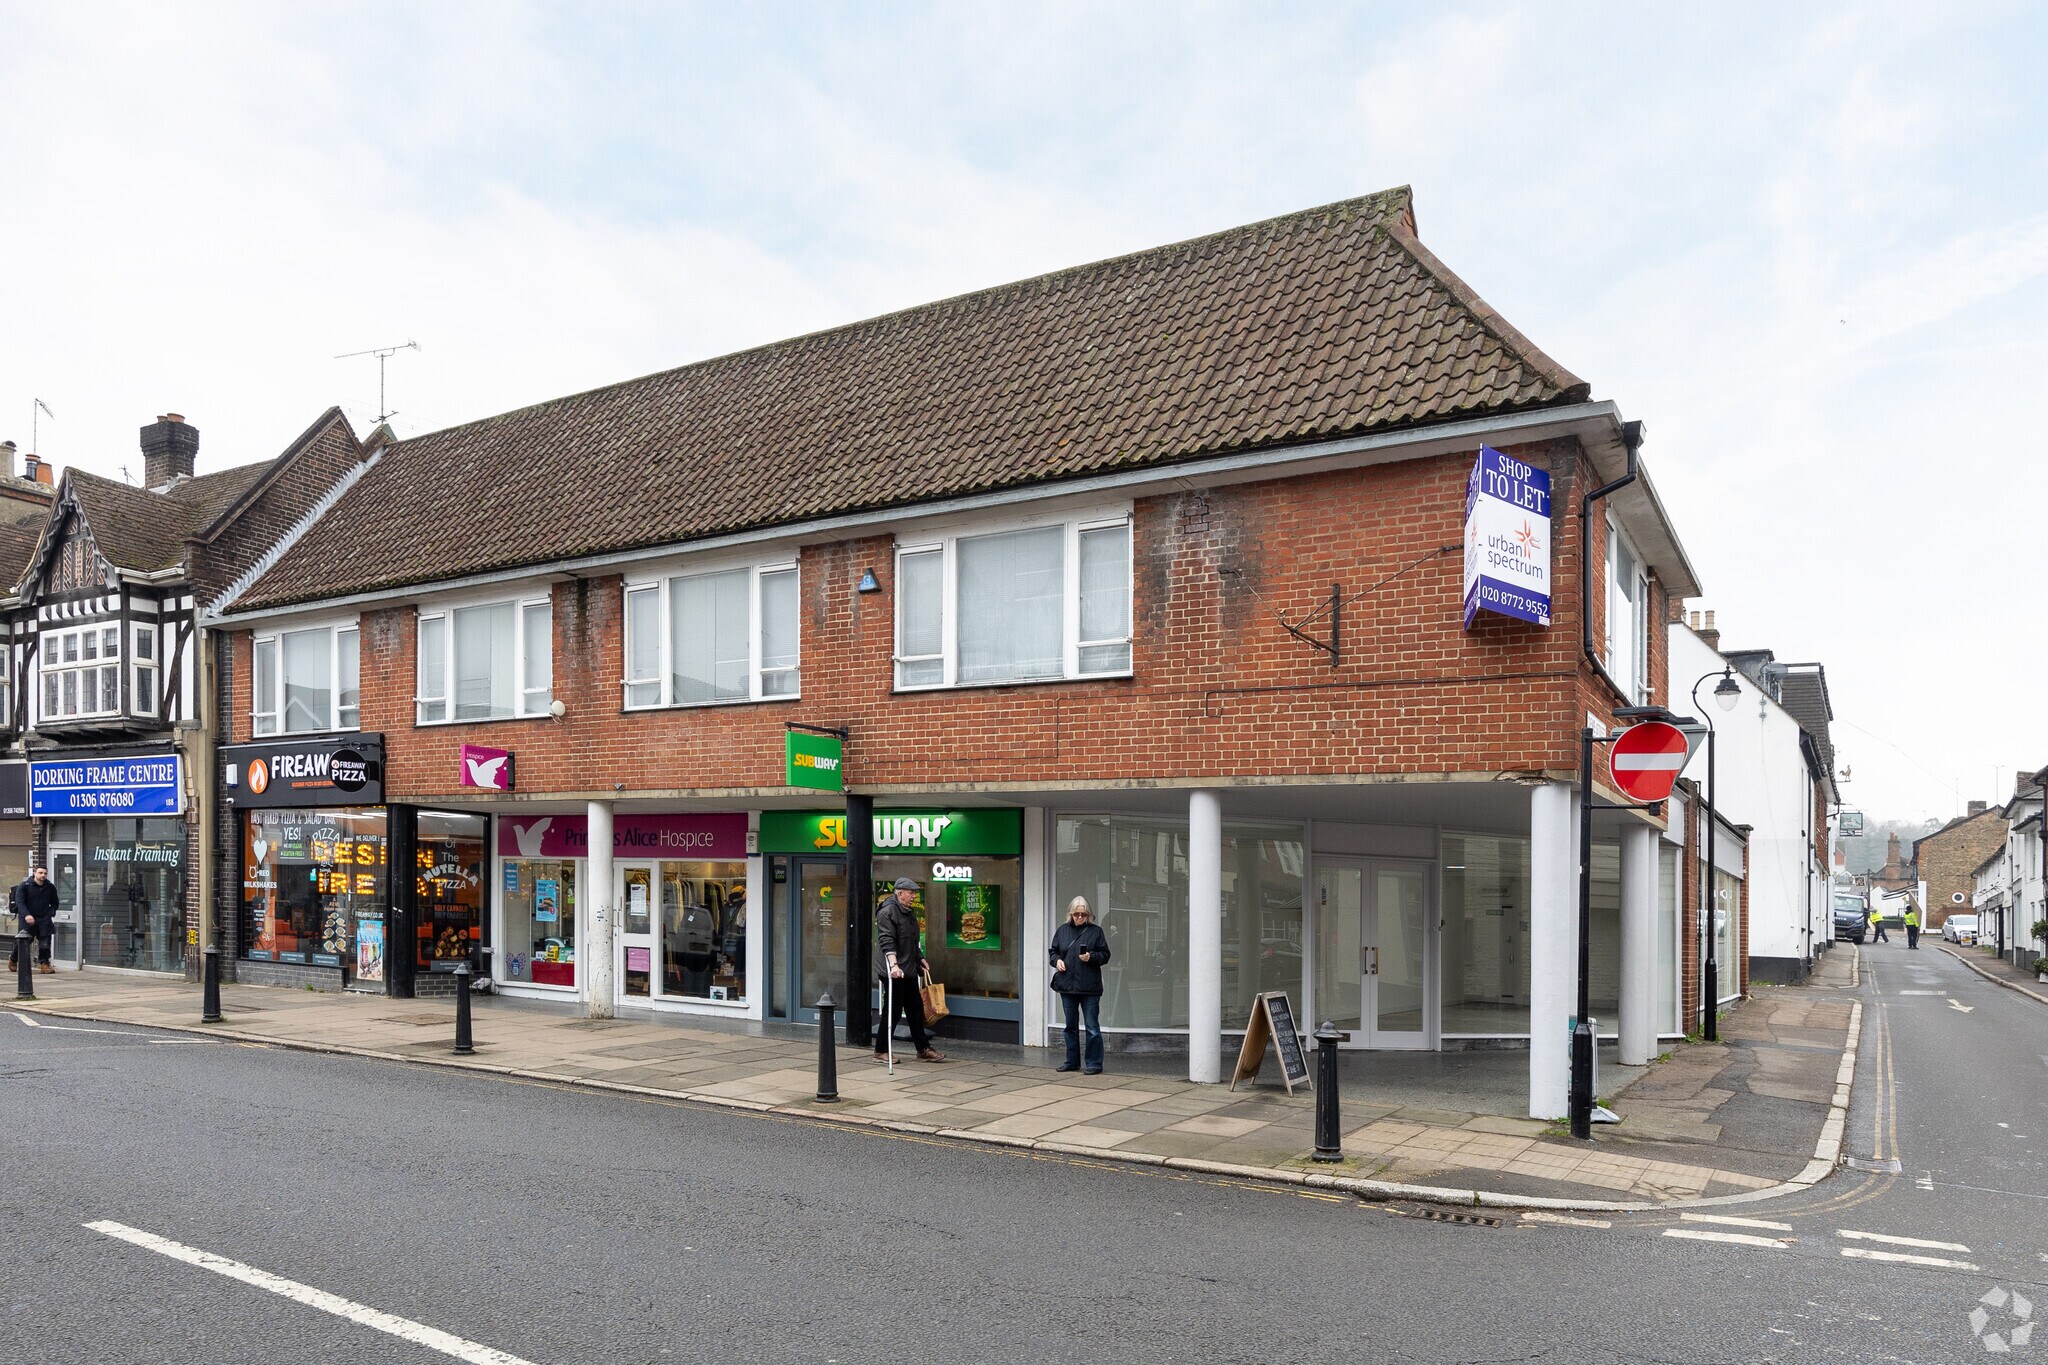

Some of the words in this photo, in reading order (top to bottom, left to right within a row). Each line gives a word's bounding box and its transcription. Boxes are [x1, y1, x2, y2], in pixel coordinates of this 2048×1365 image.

[1499, 455, 1532, 482] SHOP
[1486, 468, 1508, 498] TO
[1514, 480, 1545, 512] LET
[1488, 534, 1523, 557] urban
[1487, 550, 1543, 580] spectrum
[1482, 585, 1499, 602] 020
[1501, 591, 1523, 610] 8772
[1525, 598, 1548, 617] 9552
[339, 760, 366, 770] FIREAWAY
[466, 752, 485, 760] Hospice
[793, 753, 839, 771] SUBWAY
[34, 767, 83, 786] DORKING
[86, 766, 125, 784] FRAME
[128, 764, 174, 782] CENTRE
[271, 753, 330, 779] FIREAW
[331, 769, 366, 782] PIZZA
[70, 793, 97, 808] 01306
[99, 792, 135, 807] 876080
[165, 798, 174, 806] 188
[281, 812, 296, 824] PIZZA
[304, 812, 322, 825] SALAD
[283, 827, 301, 840] YES!
[312, 827, 340, 842] PIZZA
[565, 828, 621, 846] Prins
[623, 827, 658, 846] Alice
[660, 829, 714, 852] Hospice
[813, 815, 952, 849] SUWAY
[94, 846, 131, 861] Instant
[133, 847, 180, 867] Framing
[442, 851, 459, 863] The
[422, 863, 479, 887] NUTELLA
[932, 862, 973, 882] Open
[244, 881, 277, 889] MILKSHAKES
[437, 879, 467, 889] PIZZA
